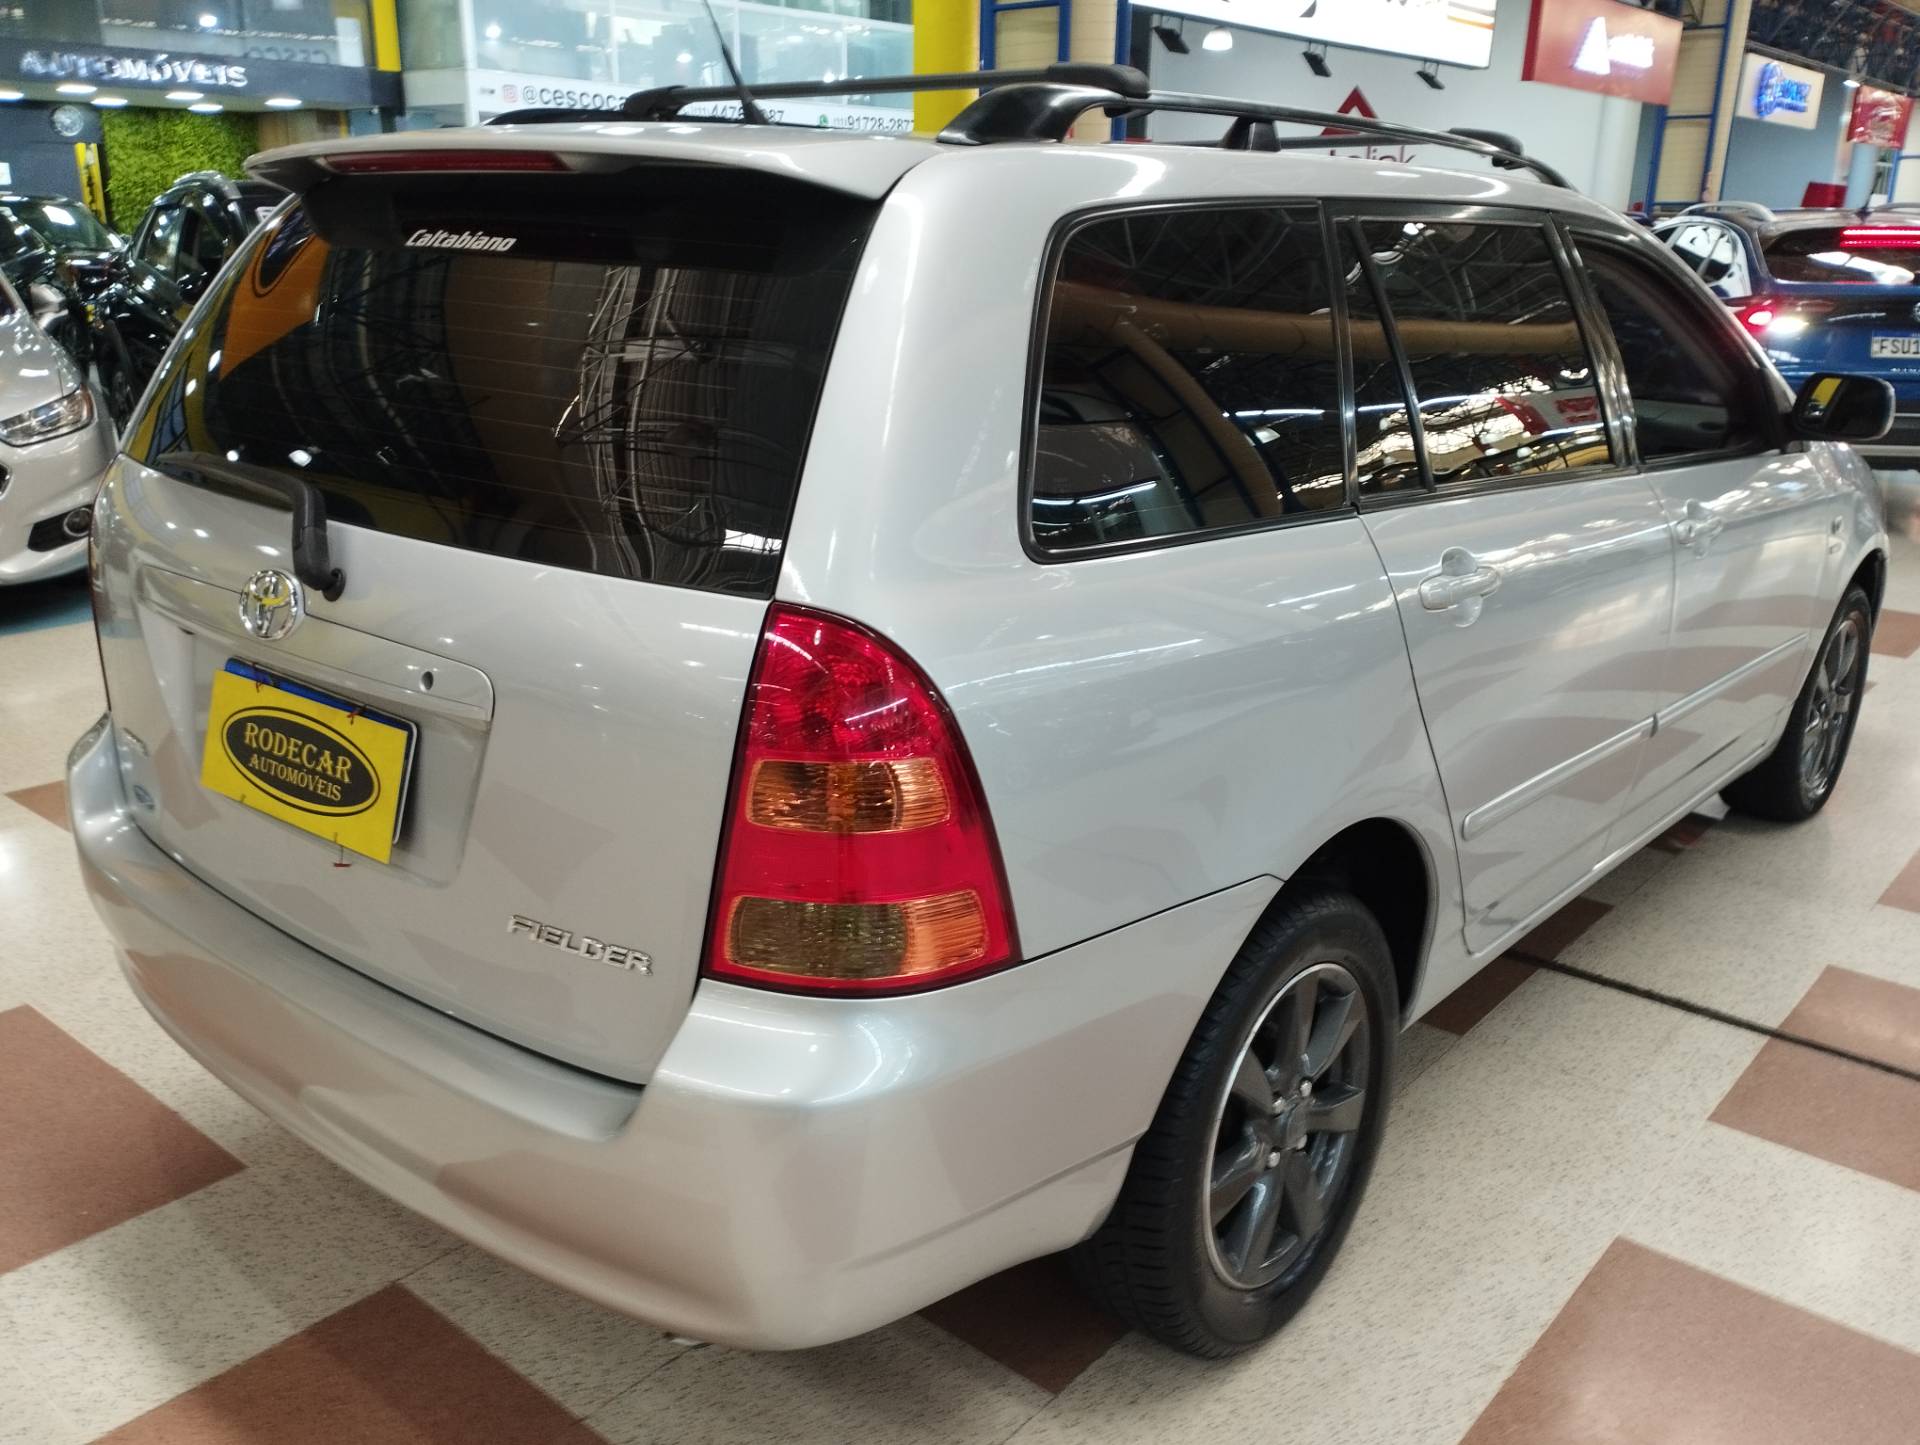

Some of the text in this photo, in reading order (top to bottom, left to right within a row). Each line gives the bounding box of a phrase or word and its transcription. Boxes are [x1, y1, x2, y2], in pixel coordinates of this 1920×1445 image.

[20, 50, 248, 88] AUTOMÓVEIS
[405, 229, 517, 251] Caltabiano
[243, 721, 352, 784] RODECAR
[248, 752, 343, 803] AUTOMÓVEIS
[507, 914, 655, 977] FIELDER
